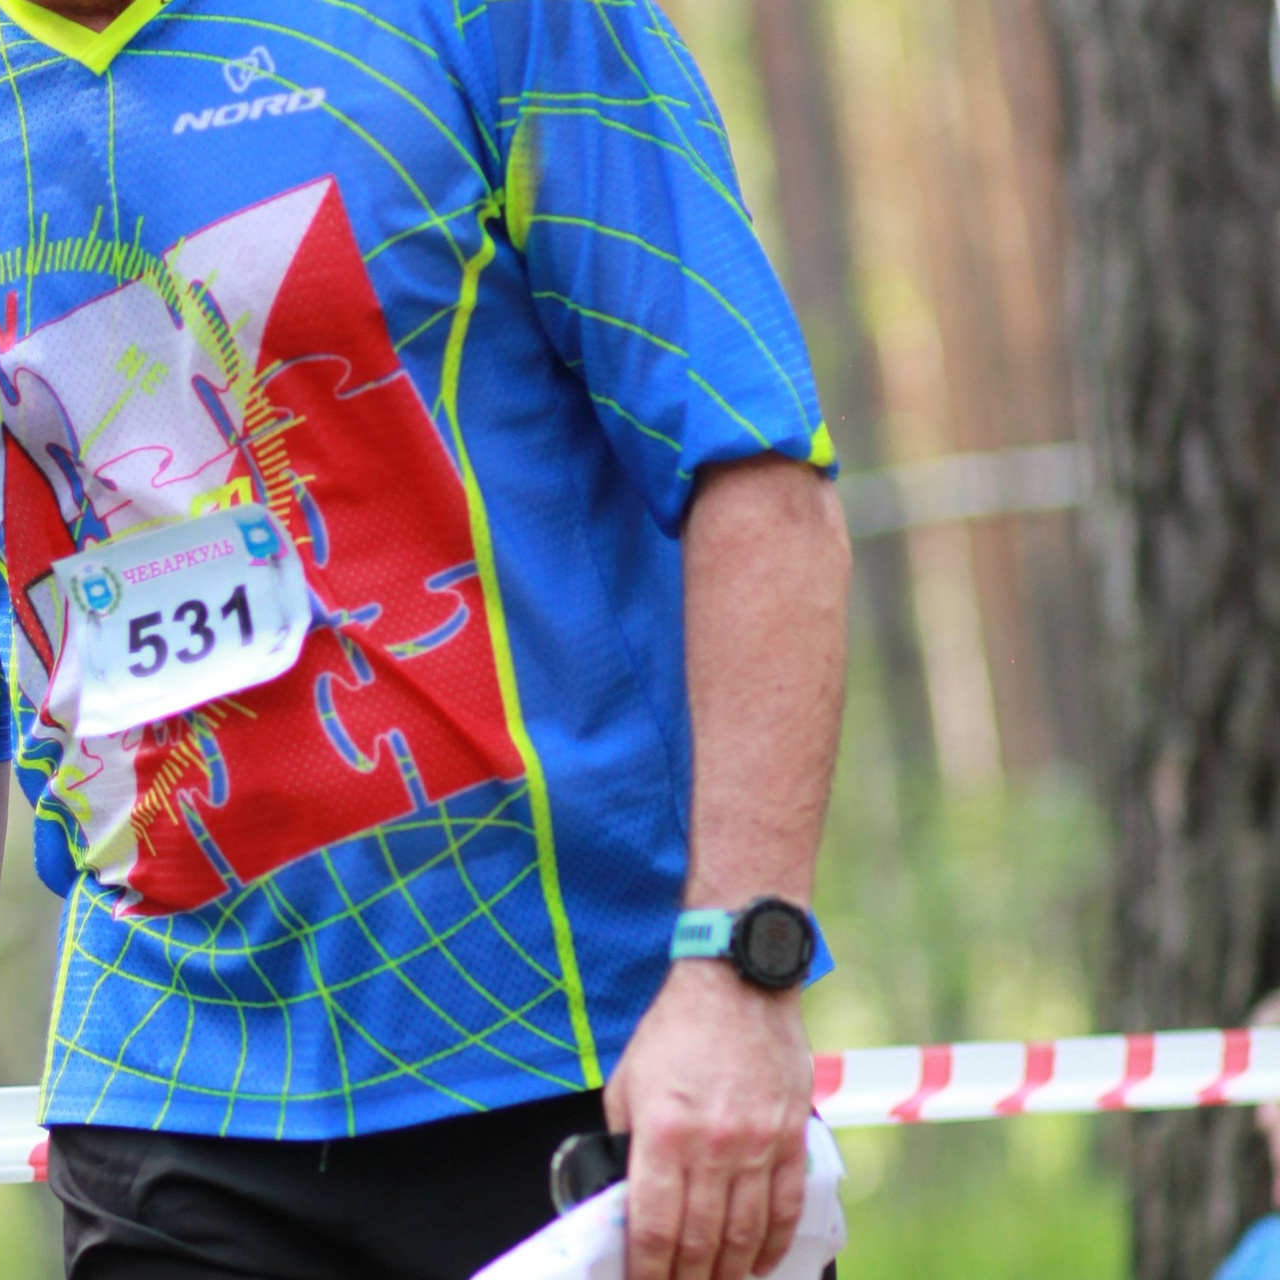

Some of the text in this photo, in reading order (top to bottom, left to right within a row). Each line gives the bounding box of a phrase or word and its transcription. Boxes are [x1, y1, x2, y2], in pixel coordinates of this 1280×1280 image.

[172, 88, 326, 135] NORD
[123, 539, 235, 585] ЧЕБАРКУЛЬ
[128, 583, 254, 678] 531
